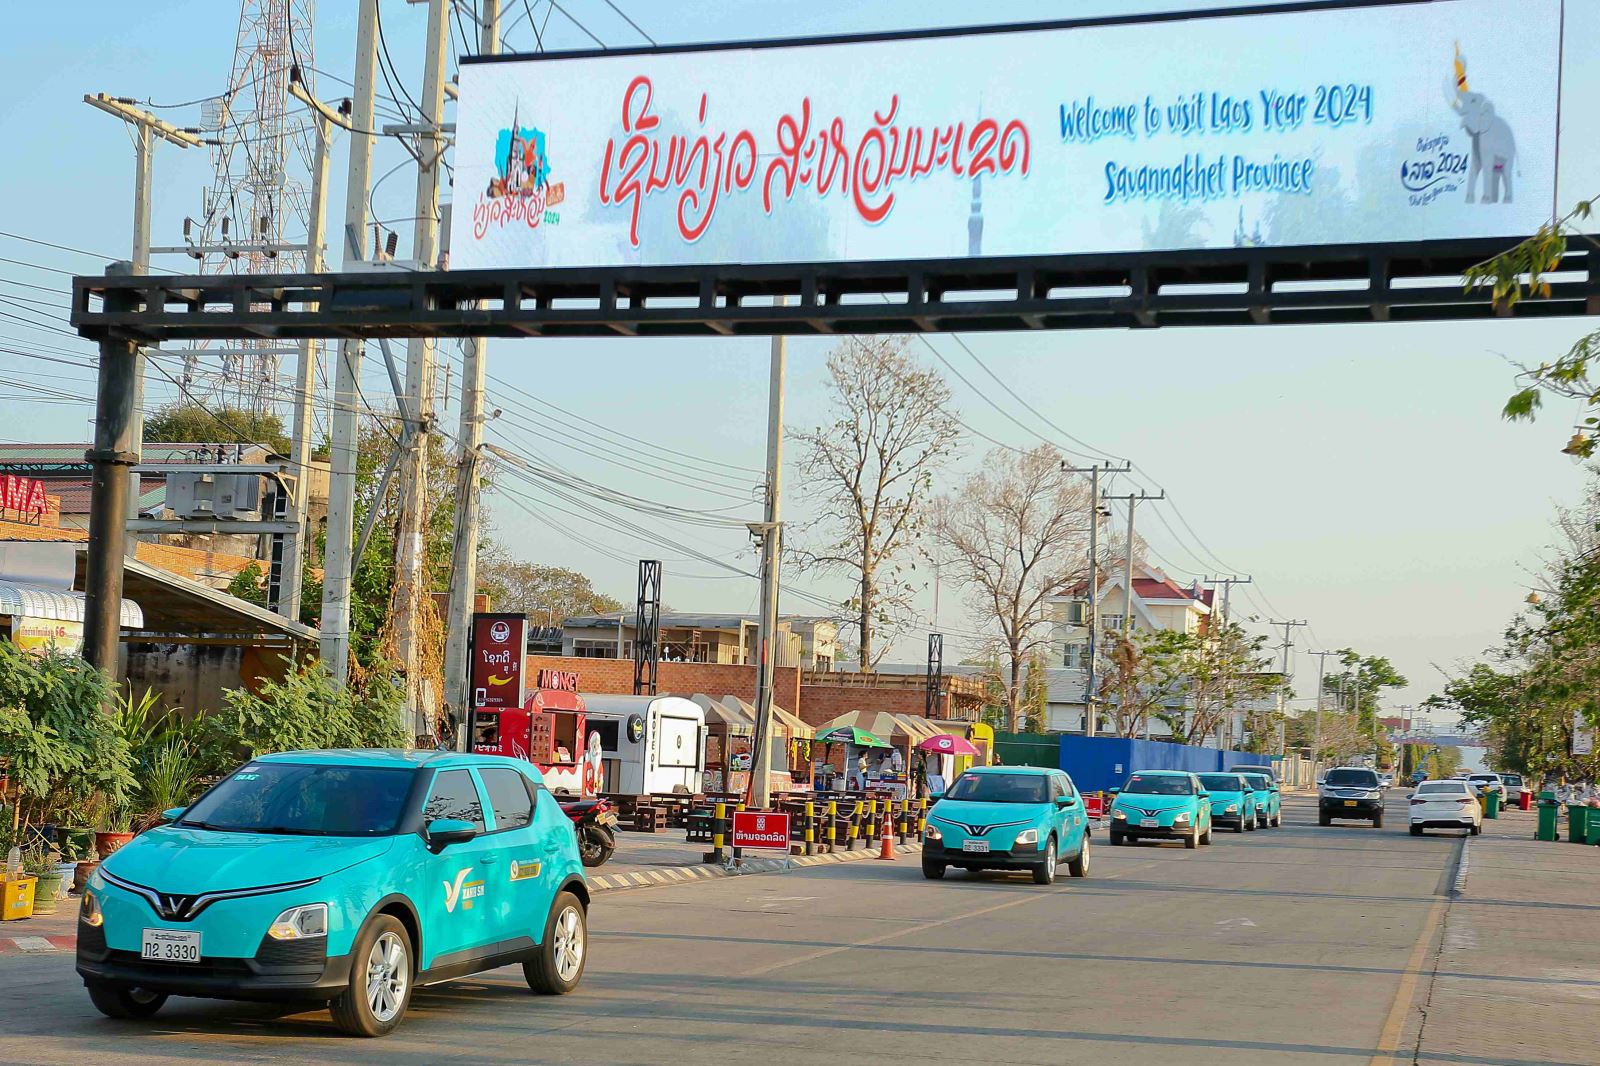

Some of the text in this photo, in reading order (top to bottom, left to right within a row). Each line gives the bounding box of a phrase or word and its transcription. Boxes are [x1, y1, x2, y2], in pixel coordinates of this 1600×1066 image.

[1060, 84, 1371, 139] Welcome to visit Laos Year 2024
[1436, 152, 1469, 174] 2024
[1104, 153, 1314, 201] Savannakhet Province
[541, 669, 580, 691] MONKEY
[165, 944, 197, 960] 3330
